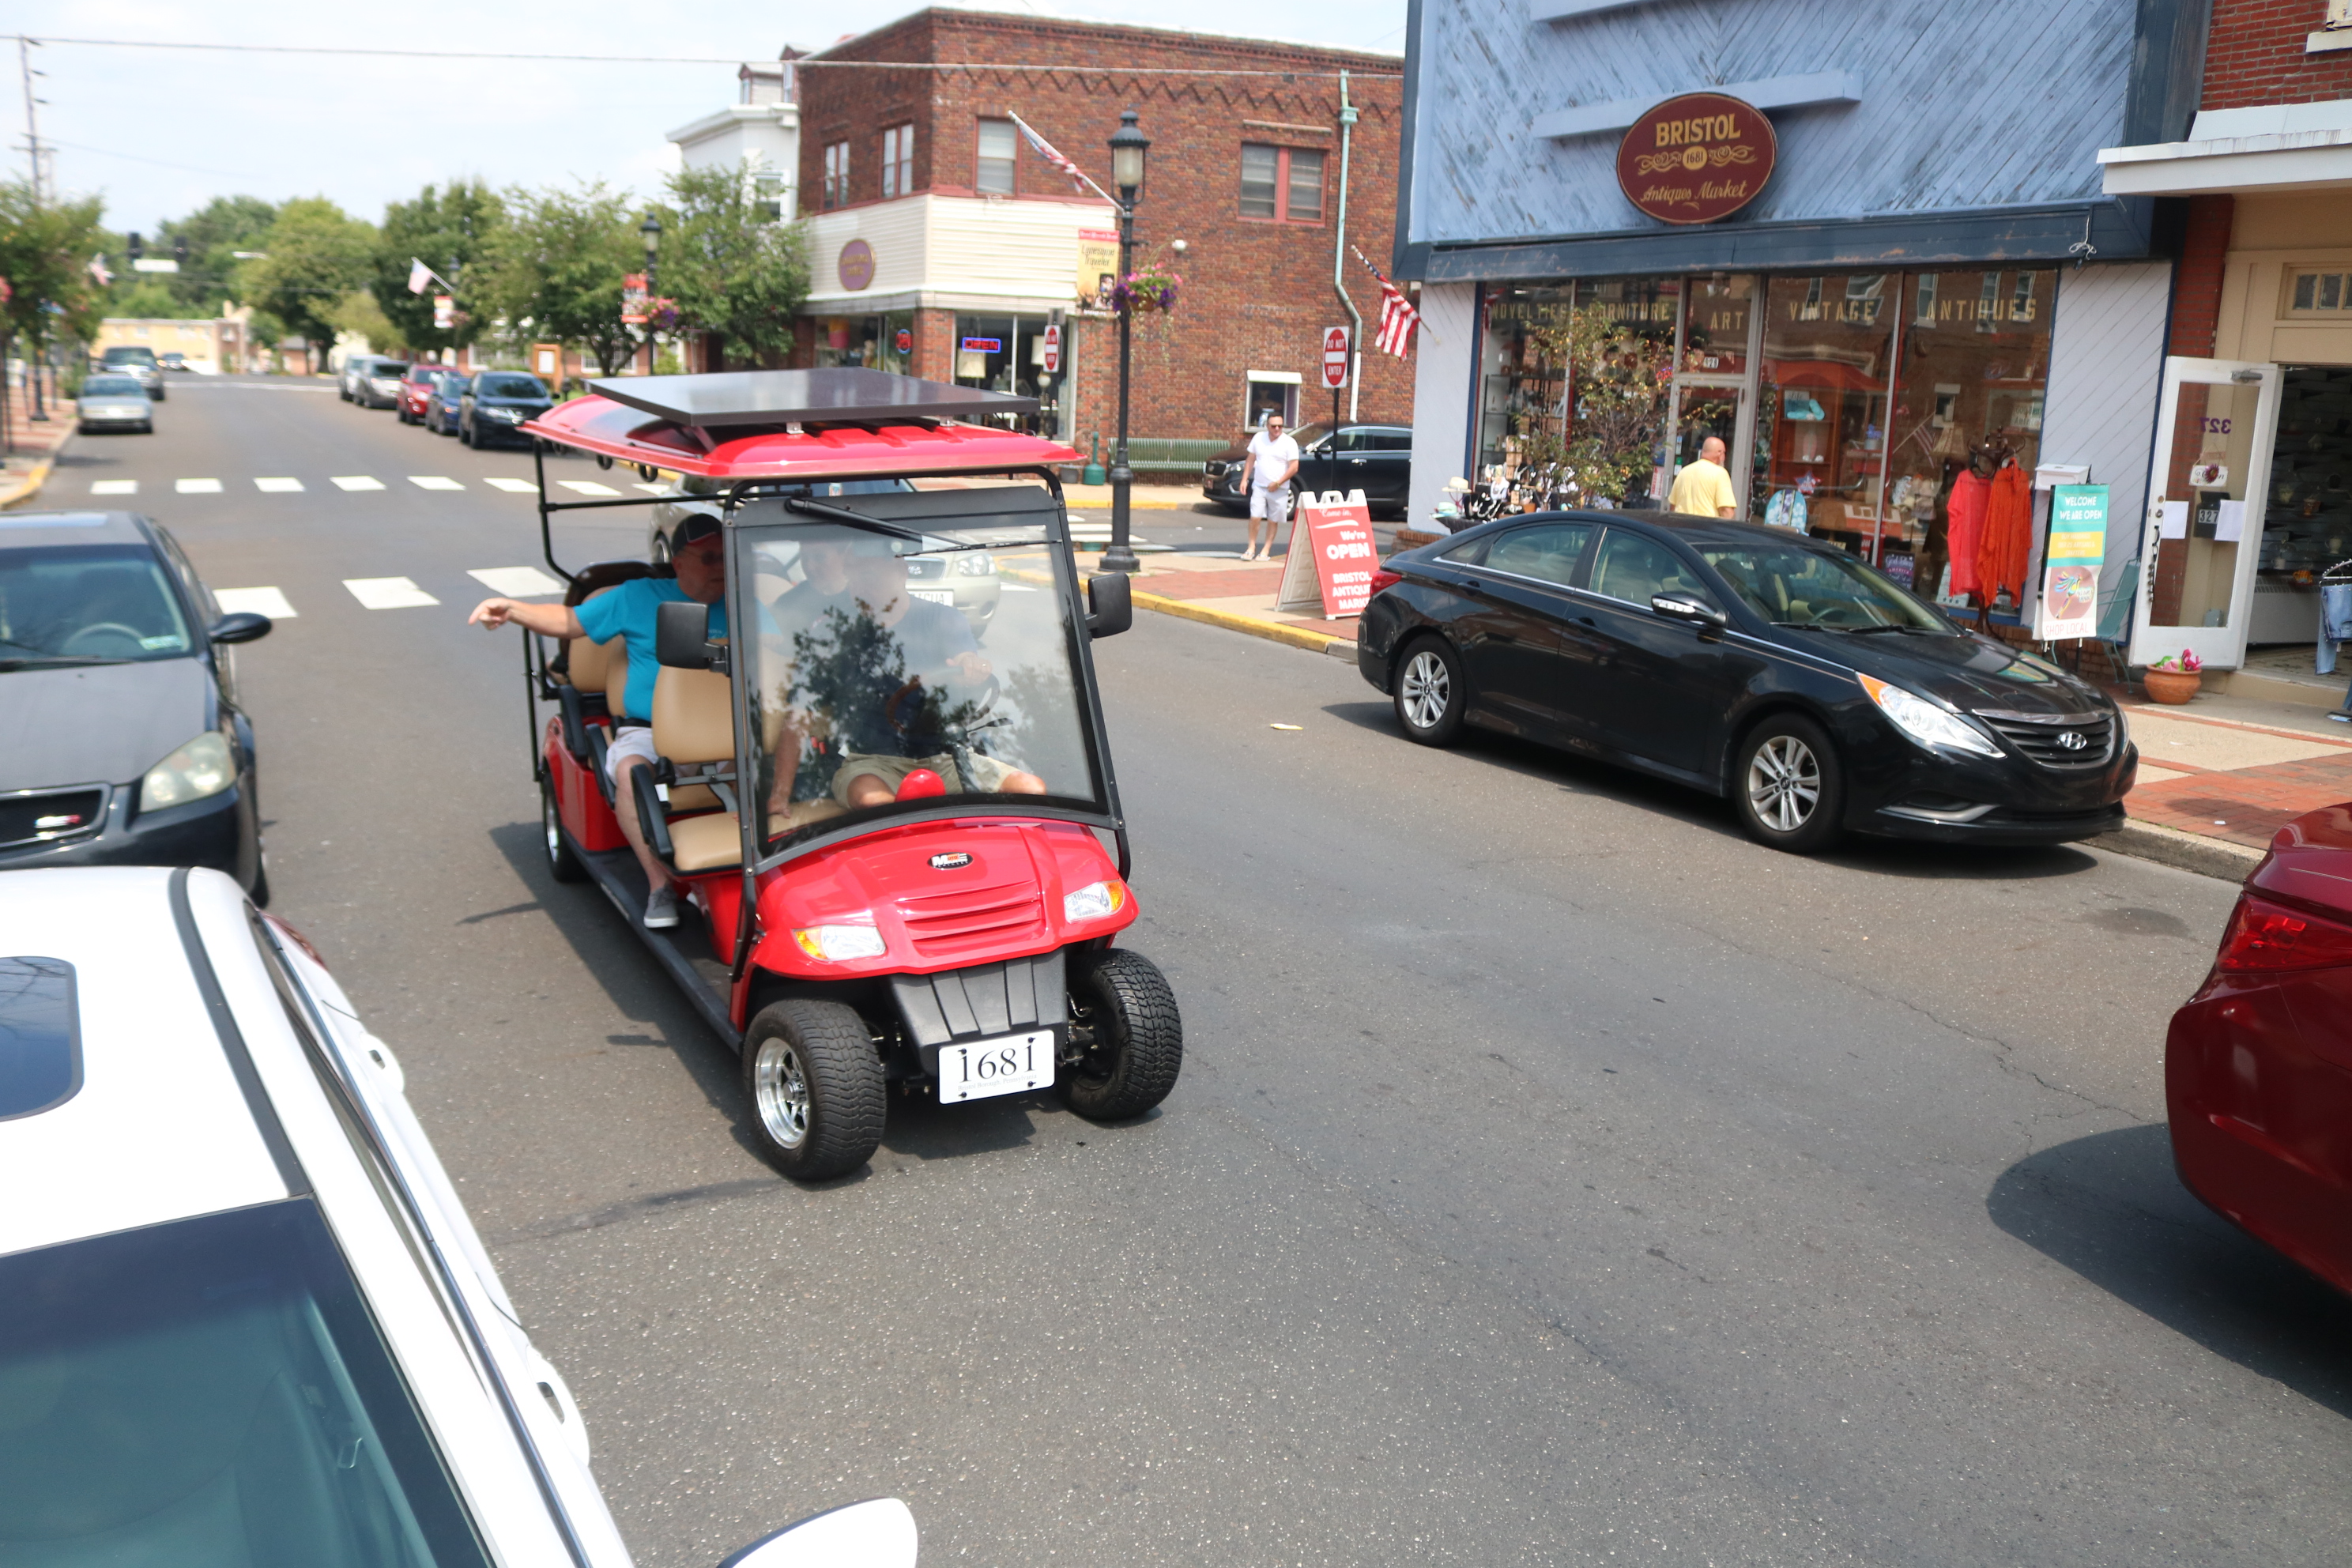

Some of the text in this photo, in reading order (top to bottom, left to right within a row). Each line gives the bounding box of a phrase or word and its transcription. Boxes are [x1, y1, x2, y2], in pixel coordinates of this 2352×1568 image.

[1656, 113, 1741, 148] BRISTOL
[1687, 152, 1704, 164] 1681
[1640, 179, 1748, 206] Antiques Market
[1789, 298, 2037, 321] VINTAGE ANTIQUES
[1710, 311, 1743, 330] ART
[964, 340, 999, 351] OPEN
[1328, 338, 1344, 349] DO NOT
[1328, 365, 1342, 375] ENTER
[2065, 496, 2097, 507] WELCOME
[1319, 508, 1341, 518] Come
[2060, 510, 2102, 520] WE ARE OPEN
[2199, 510, 2219, 523] 327
[1340, 530, 1366, 541] We're
[1327, 542, 1370, 560] OPEN
[1332, 571, 1373, 584] BRISTOL
[2045, 622, 2089, 637] SHOP LOCAL
[958, 1044, 1036, 1084] 1681
[977, 1080, 1001, 1089] Borough,
[1003, 1073, 1037, 1084] Pennsylvania
